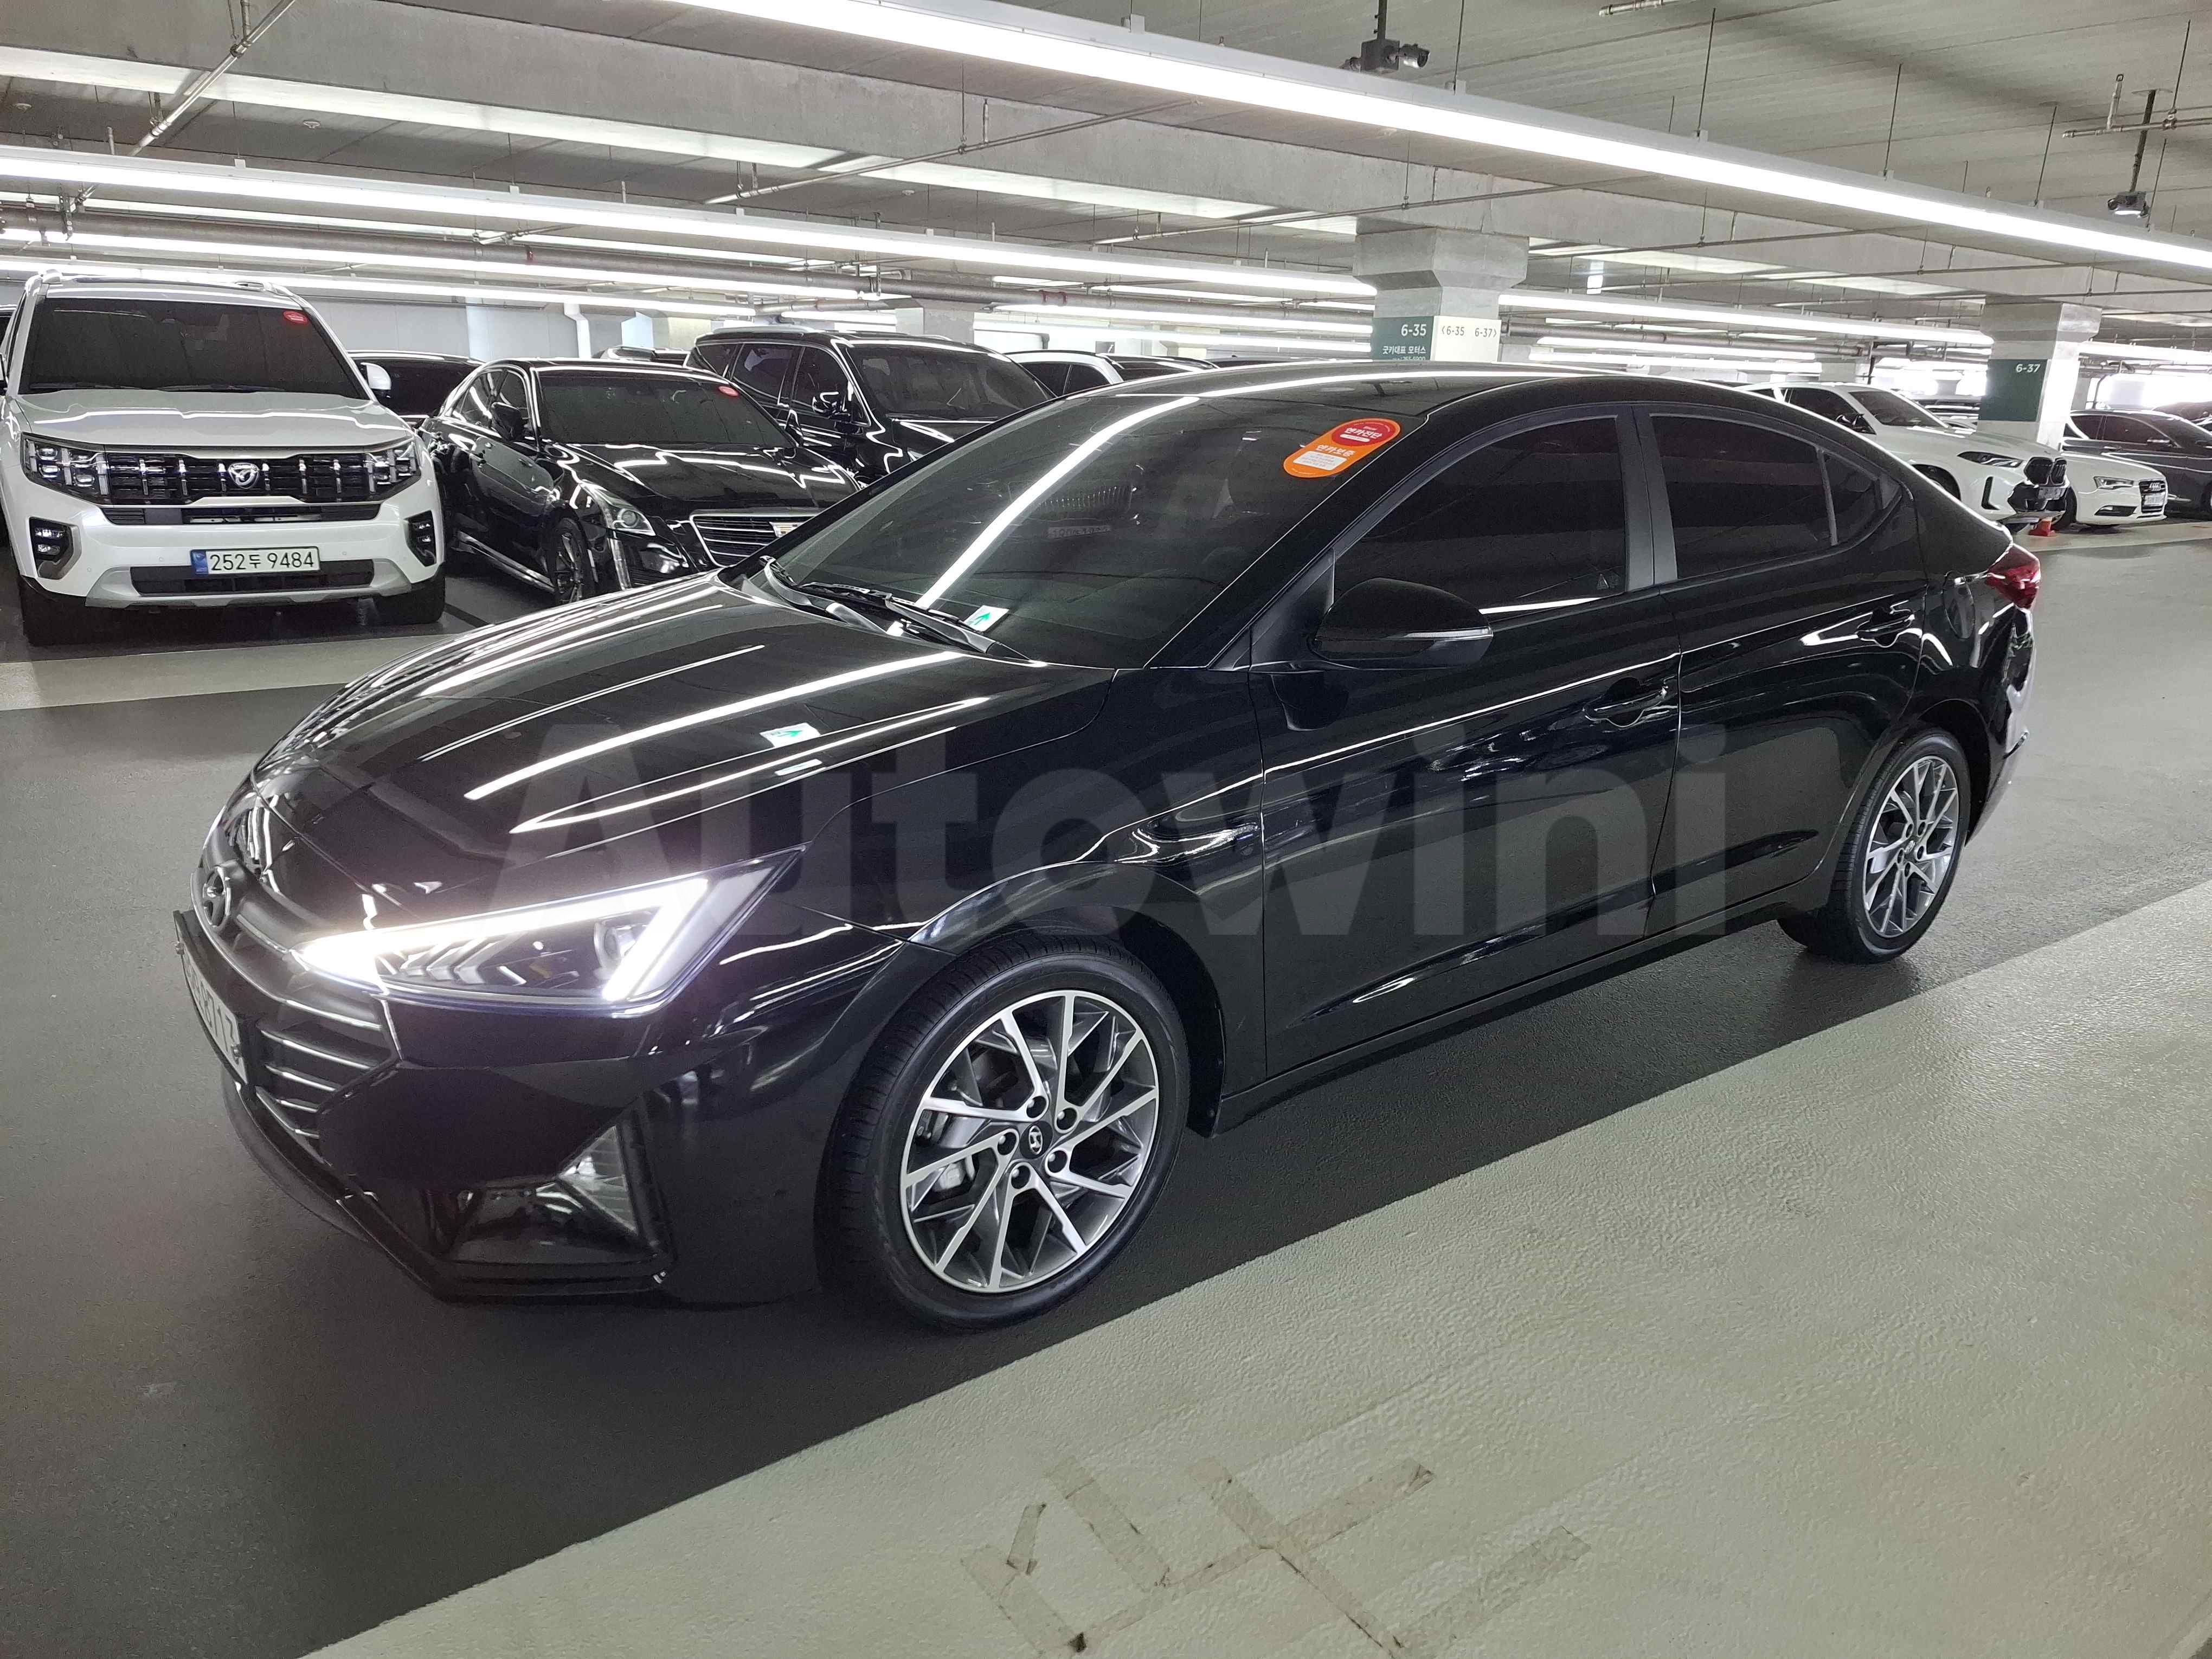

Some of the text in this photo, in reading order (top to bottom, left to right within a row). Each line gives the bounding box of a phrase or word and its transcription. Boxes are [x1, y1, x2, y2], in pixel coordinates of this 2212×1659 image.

[1401, 324, 1426, 336] 6-35
[1407, 345, 1426, 354] 모터스
[2016, 364, 2040, 373] 6-37
[210, 551, 314, 571] 252두 9484
